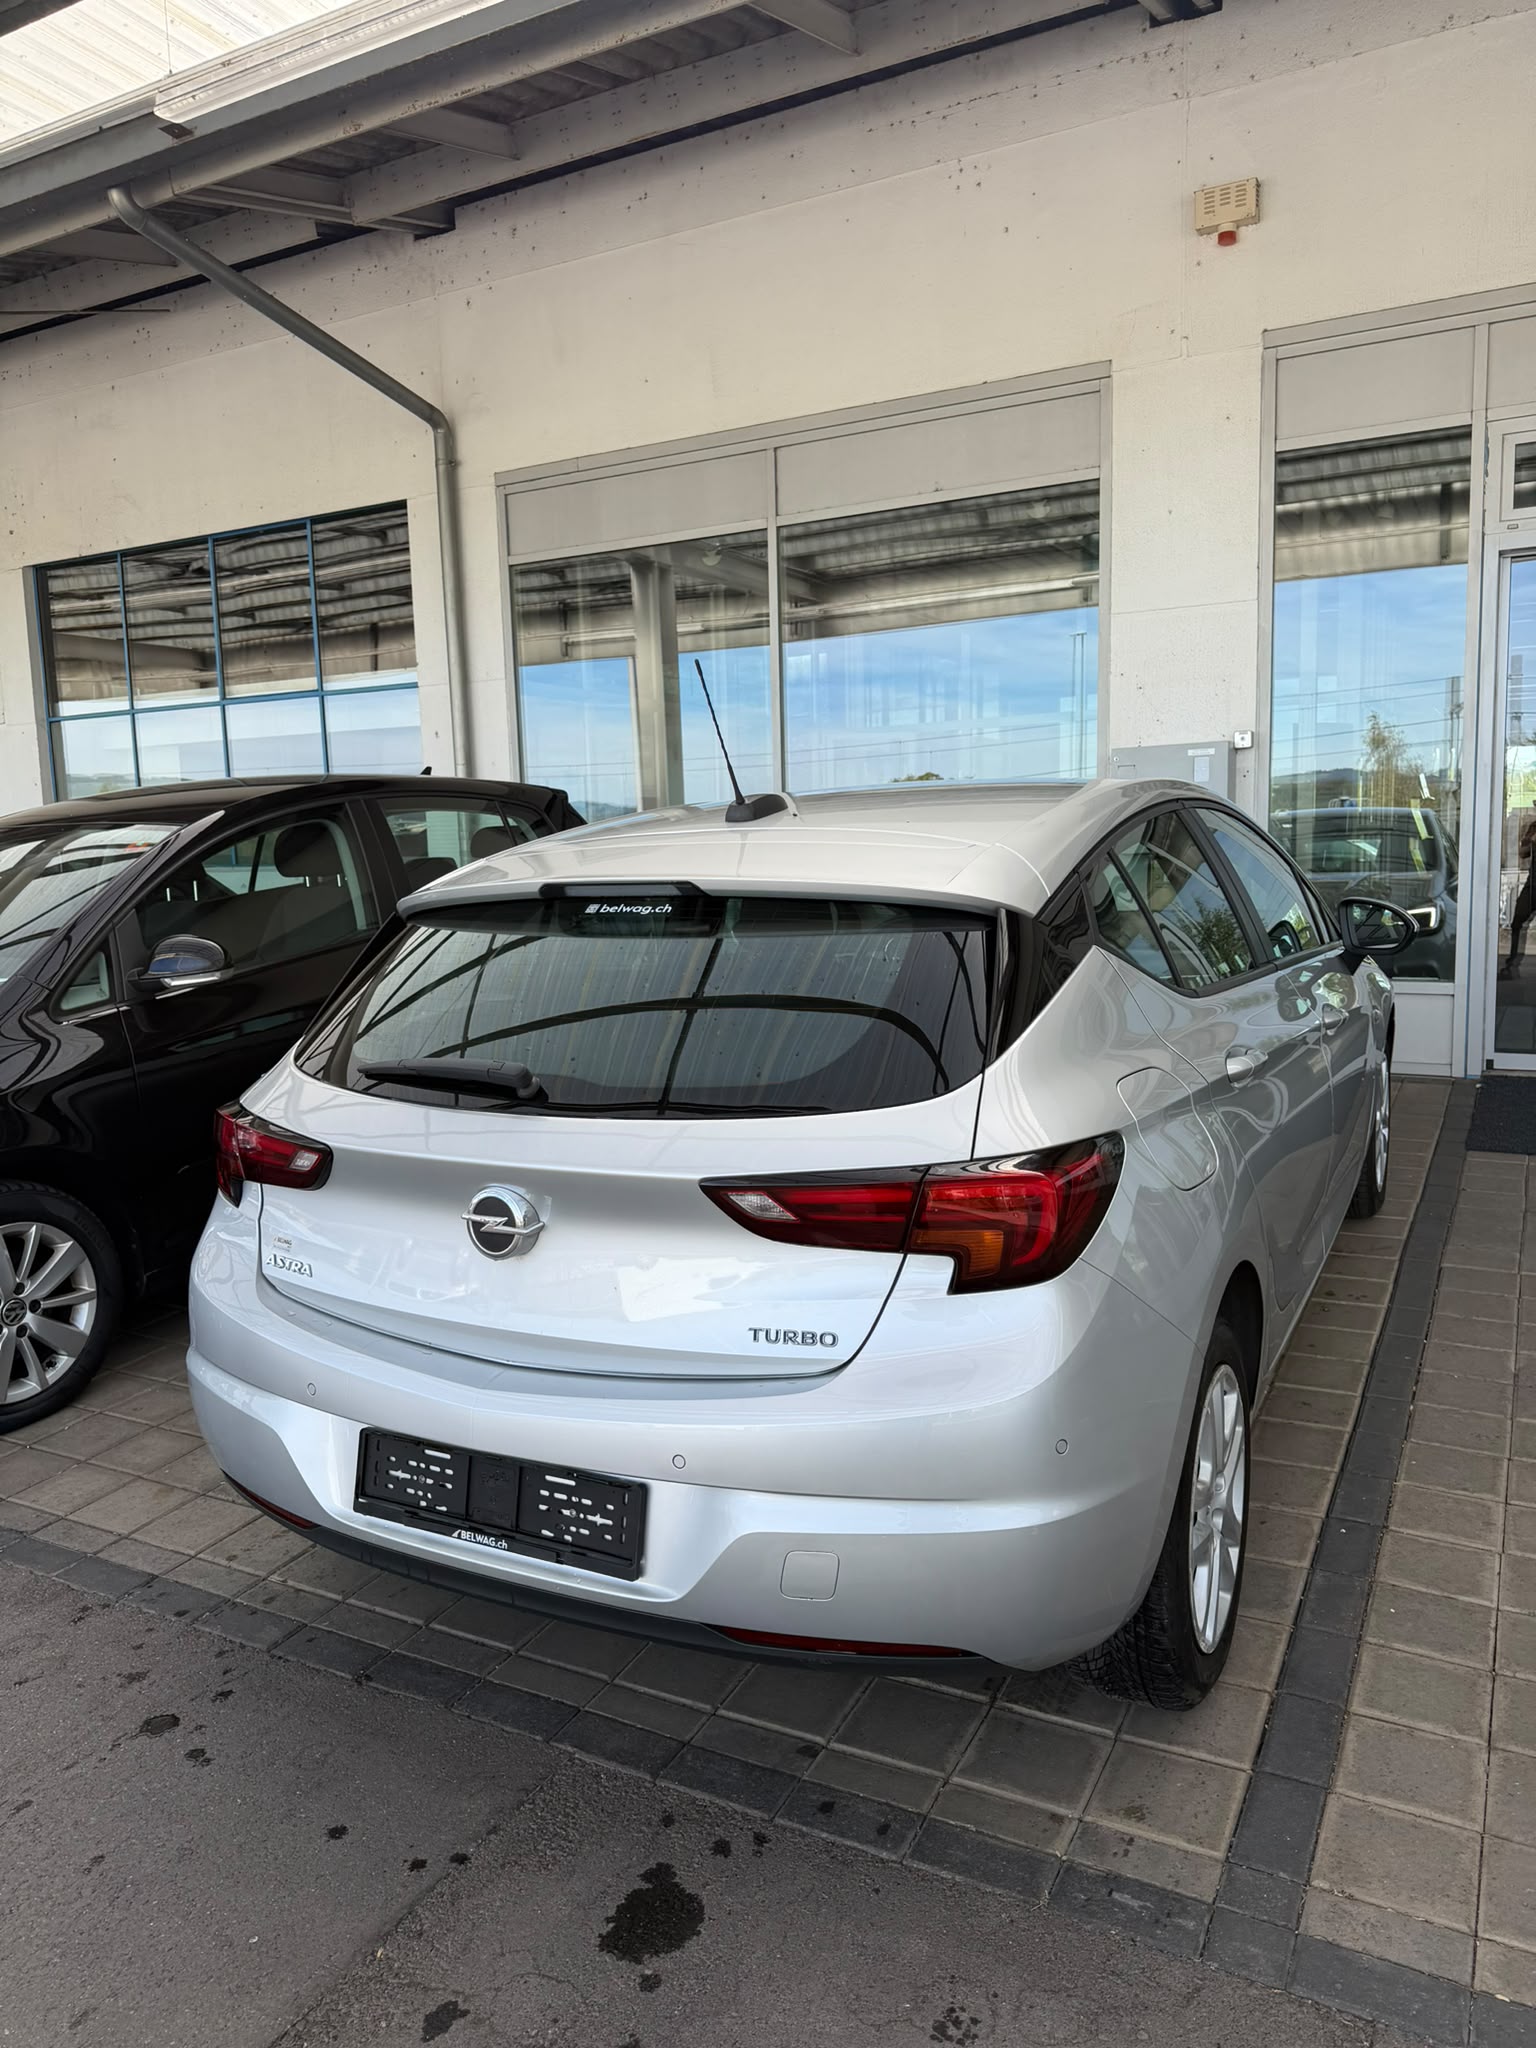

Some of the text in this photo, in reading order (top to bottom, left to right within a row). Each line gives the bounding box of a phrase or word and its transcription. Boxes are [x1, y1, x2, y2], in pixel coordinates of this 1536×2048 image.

[599, 903, 673, 915] belwag.ch
[266, 1253, 313, 1278] ASTRA
[747, 1327, 839, 1348] TURBO
[460, 1529, 508, 1550] BELWAG.ch
